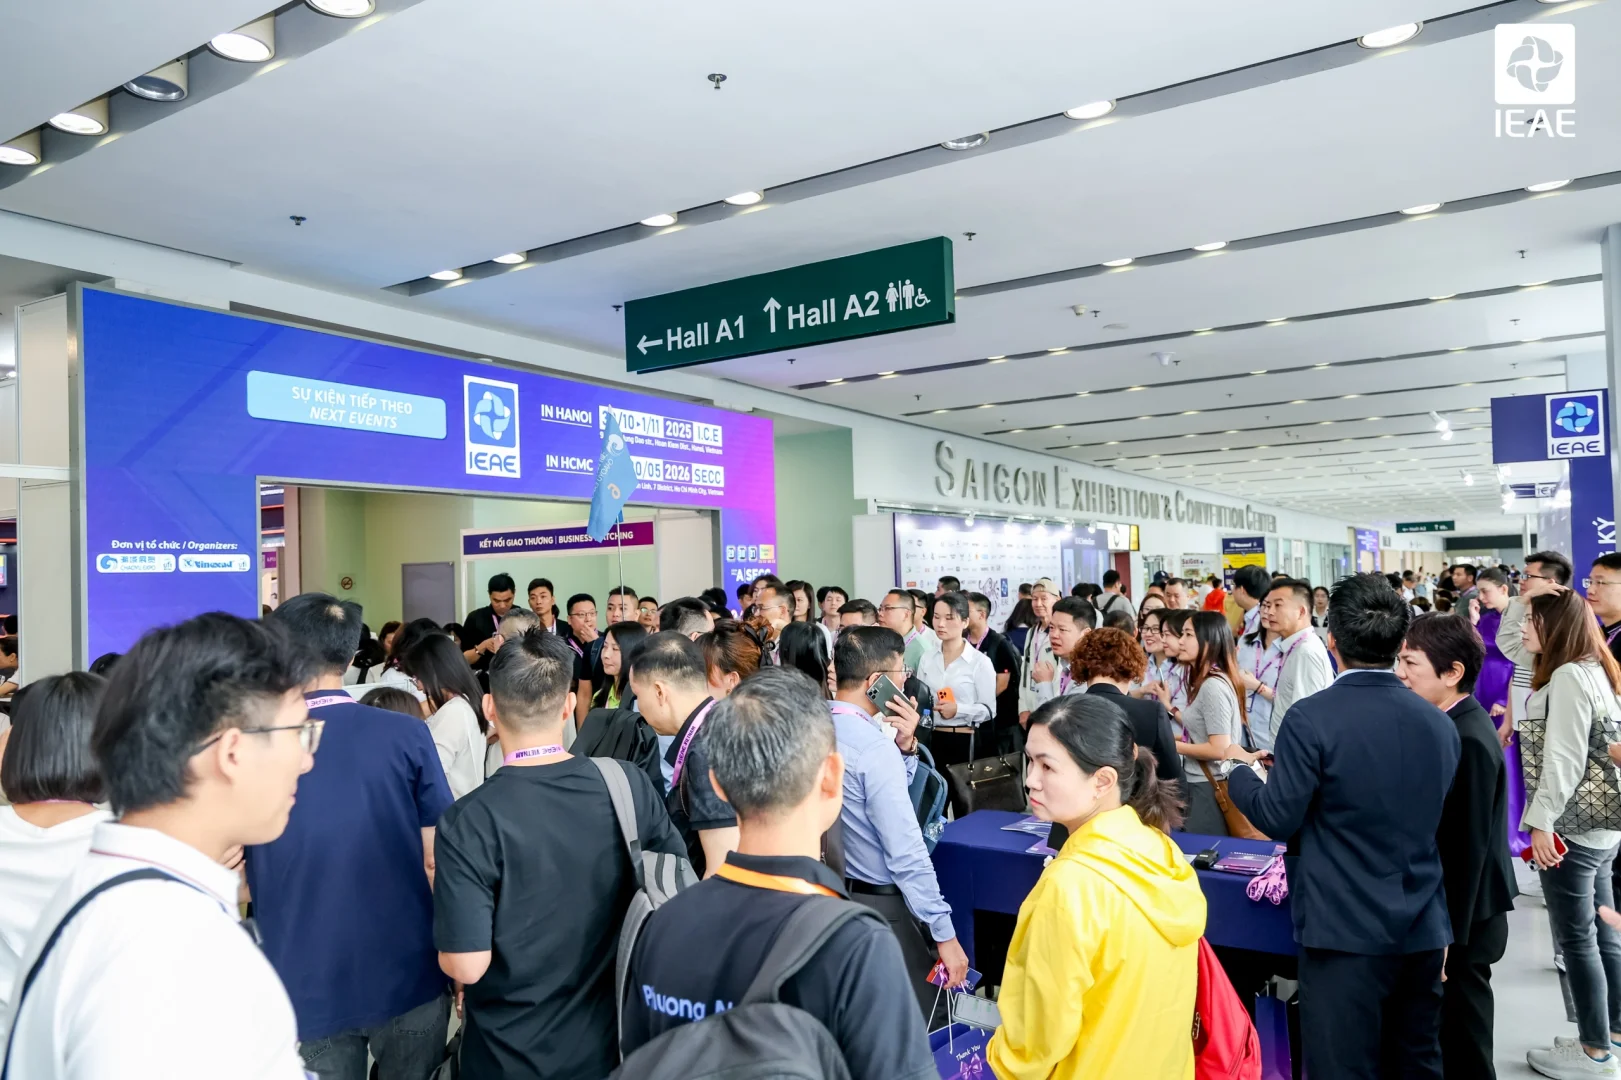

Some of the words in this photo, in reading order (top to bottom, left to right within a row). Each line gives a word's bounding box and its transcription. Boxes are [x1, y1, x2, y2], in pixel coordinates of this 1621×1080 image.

[787, 298, 836, 330] Hall
[843, 290, 880, 320] A2
[667, 322, 709, 351] Hall
[715, 315, 745, 343] A1
[314, 389, 346, 407] KIỆN
[380, 399, 413, 415] THEO
[310, 407, 346, 423] NEXT
[349, 412, 398, 429] EVENTS
[541, 404, 553, 419] IN
[555, 406, 592, 424] HANOI
[602, 410, 635, 431] 3/10
[665, 421, 692, 439] 2025
[697, 426, 719, 442] I.C.E
[1551, 440, 1601, 456] IEAE
[469, 451, 517, 474] IEAE
[546, 454, 558, 469] IN
[560, 457, 594, 471] HCMC
[635, 460, 661, 479] 0/05
[664, 463, 691, 482] 2026
[694, 468, 721, 484] SECC
[935, 440, 1046, 506] SAIGON
[111, 539, 132, 549] Đơn
[188, 541, 238, 551] Organizers:
[506, 537, 523, 546] GIAO
[558, 533, 593, 543] BUSINESS
[956, 1048, 971, 1061] Thank
